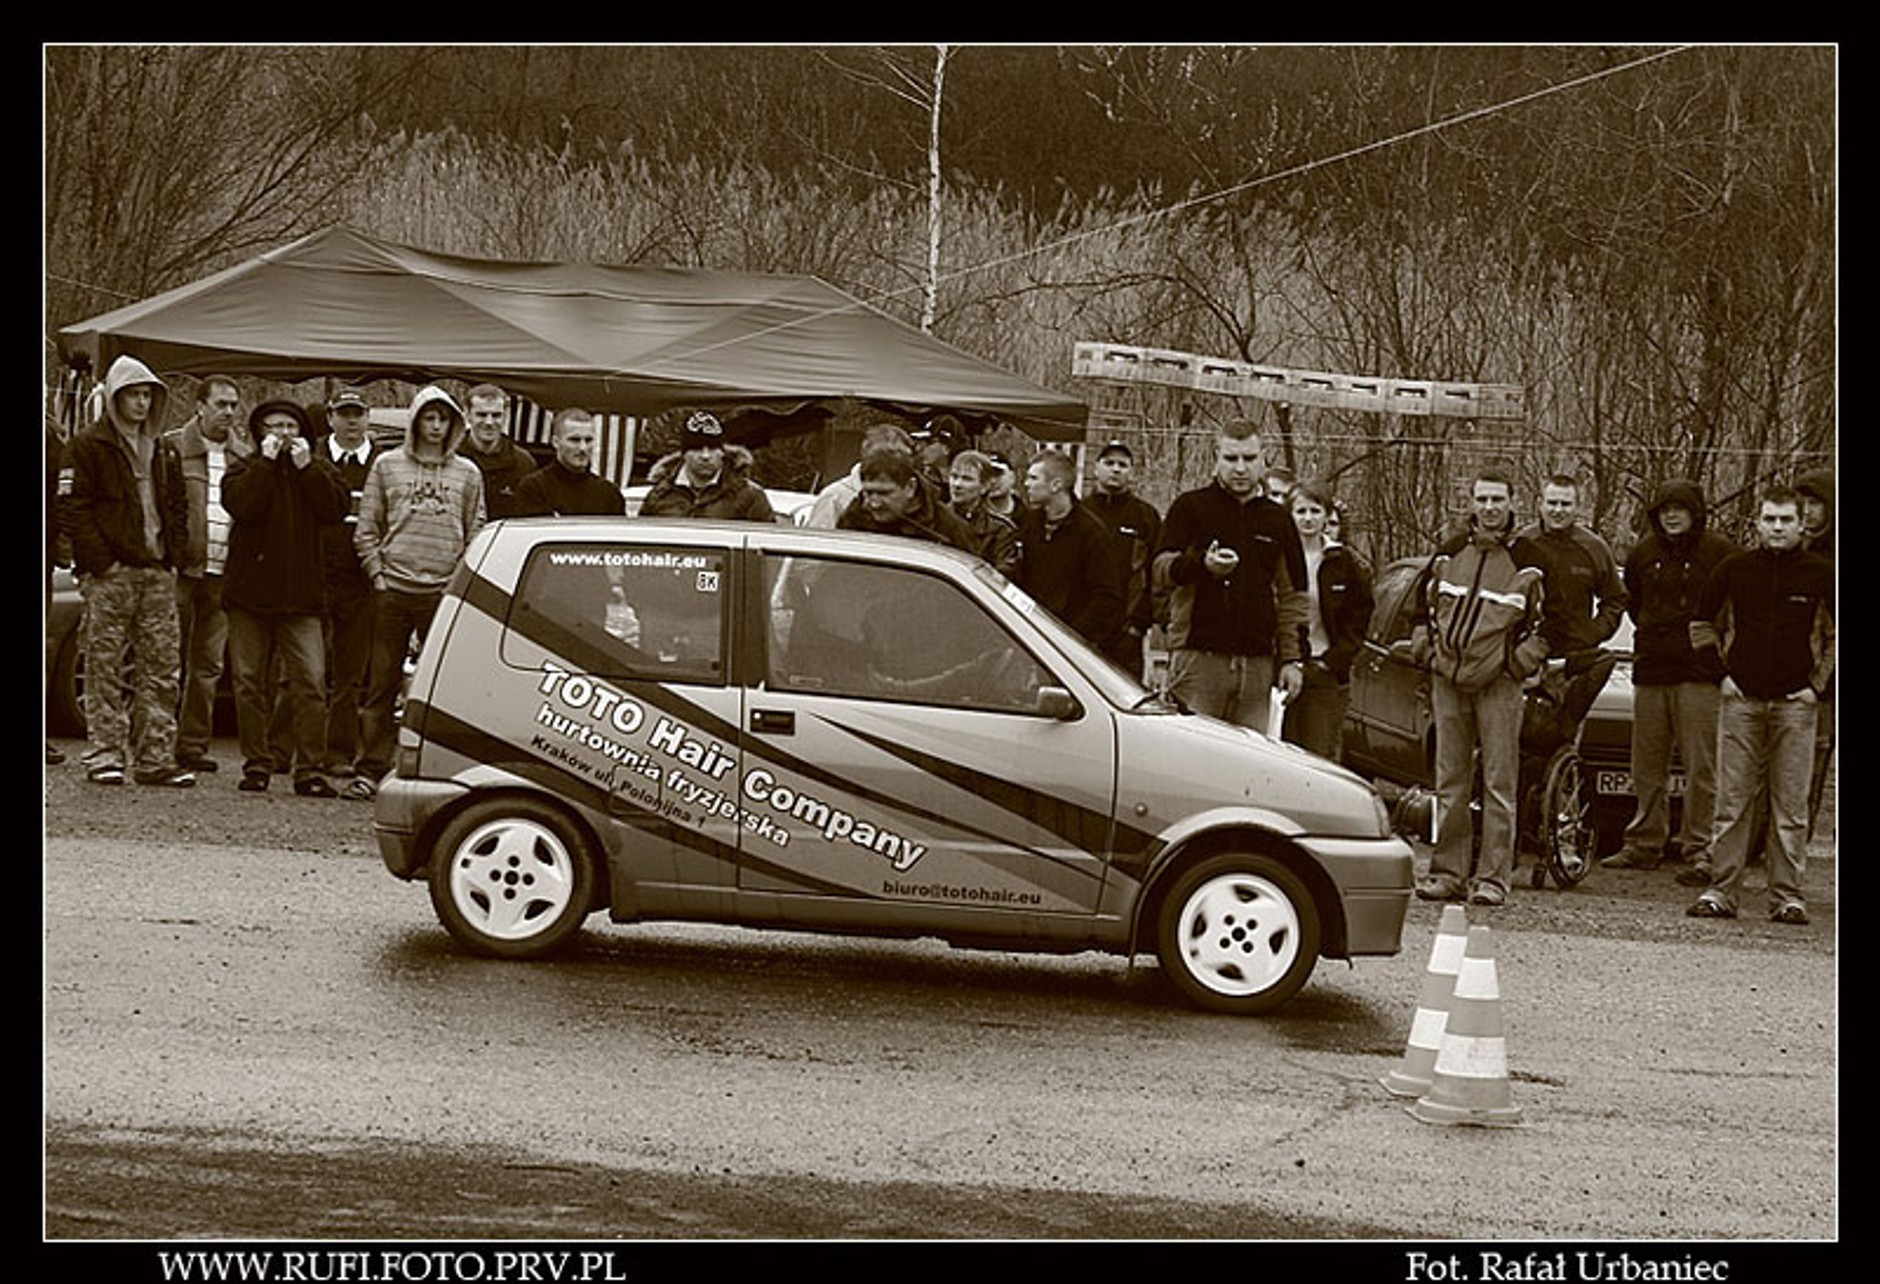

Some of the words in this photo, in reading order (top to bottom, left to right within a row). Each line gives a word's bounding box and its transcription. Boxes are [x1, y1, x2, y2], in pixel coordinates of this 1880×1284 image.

[549, 552, 707, 569] www.totohair.eu
[536, 702, 661, 782] hurtownia
[666, 769, 791, 849] fryzjerska
[537, 662, 645, 735] TOTO
[647, 717, 737, 781] Hair
[743, 768, 928, 872] Company
